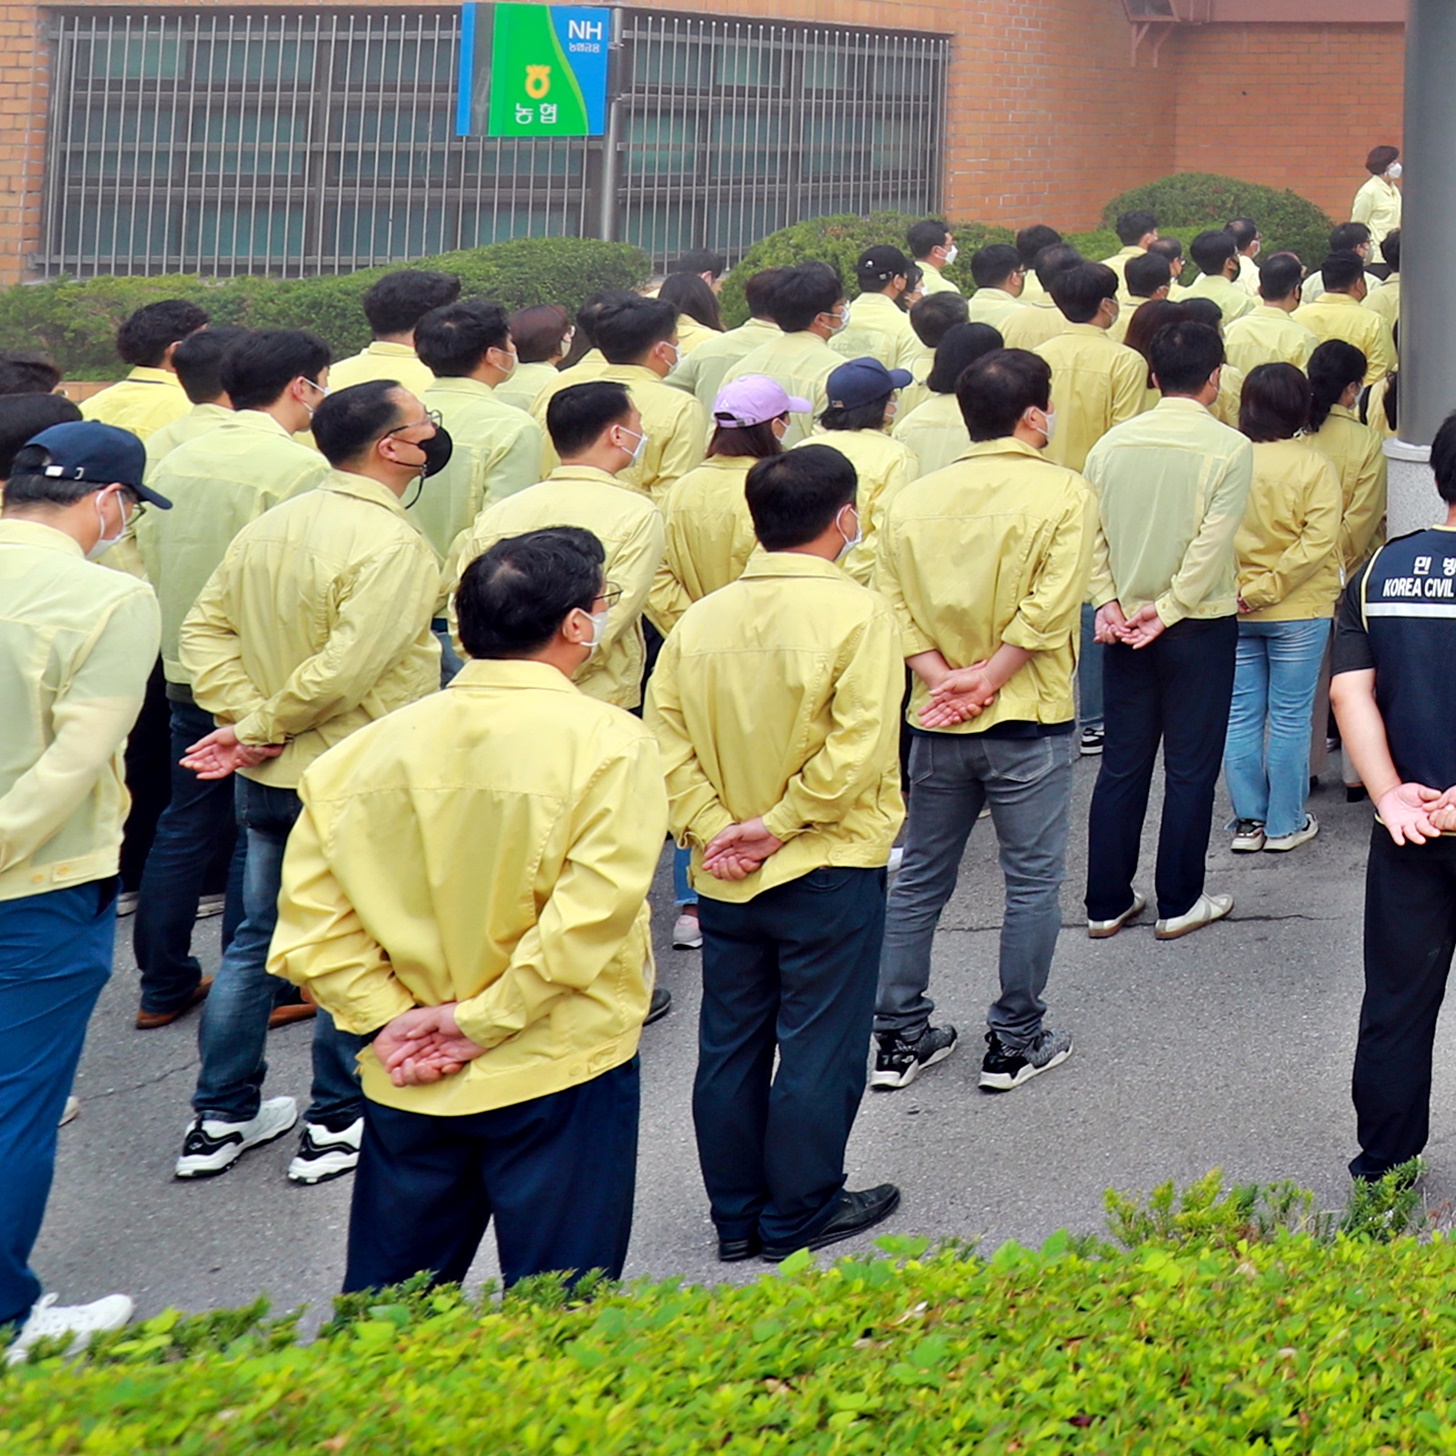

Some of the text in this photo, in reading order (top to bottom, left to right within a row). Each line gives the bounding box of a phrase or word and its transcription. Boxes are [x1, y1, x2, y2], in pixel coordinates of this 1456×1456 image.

[568, 20, 602, 40] NH
[515, 103, 557, 124] 농협
[1383, 578, 1422, 597] KOREA
[1424, 579, 1454, 597] CIVIL
